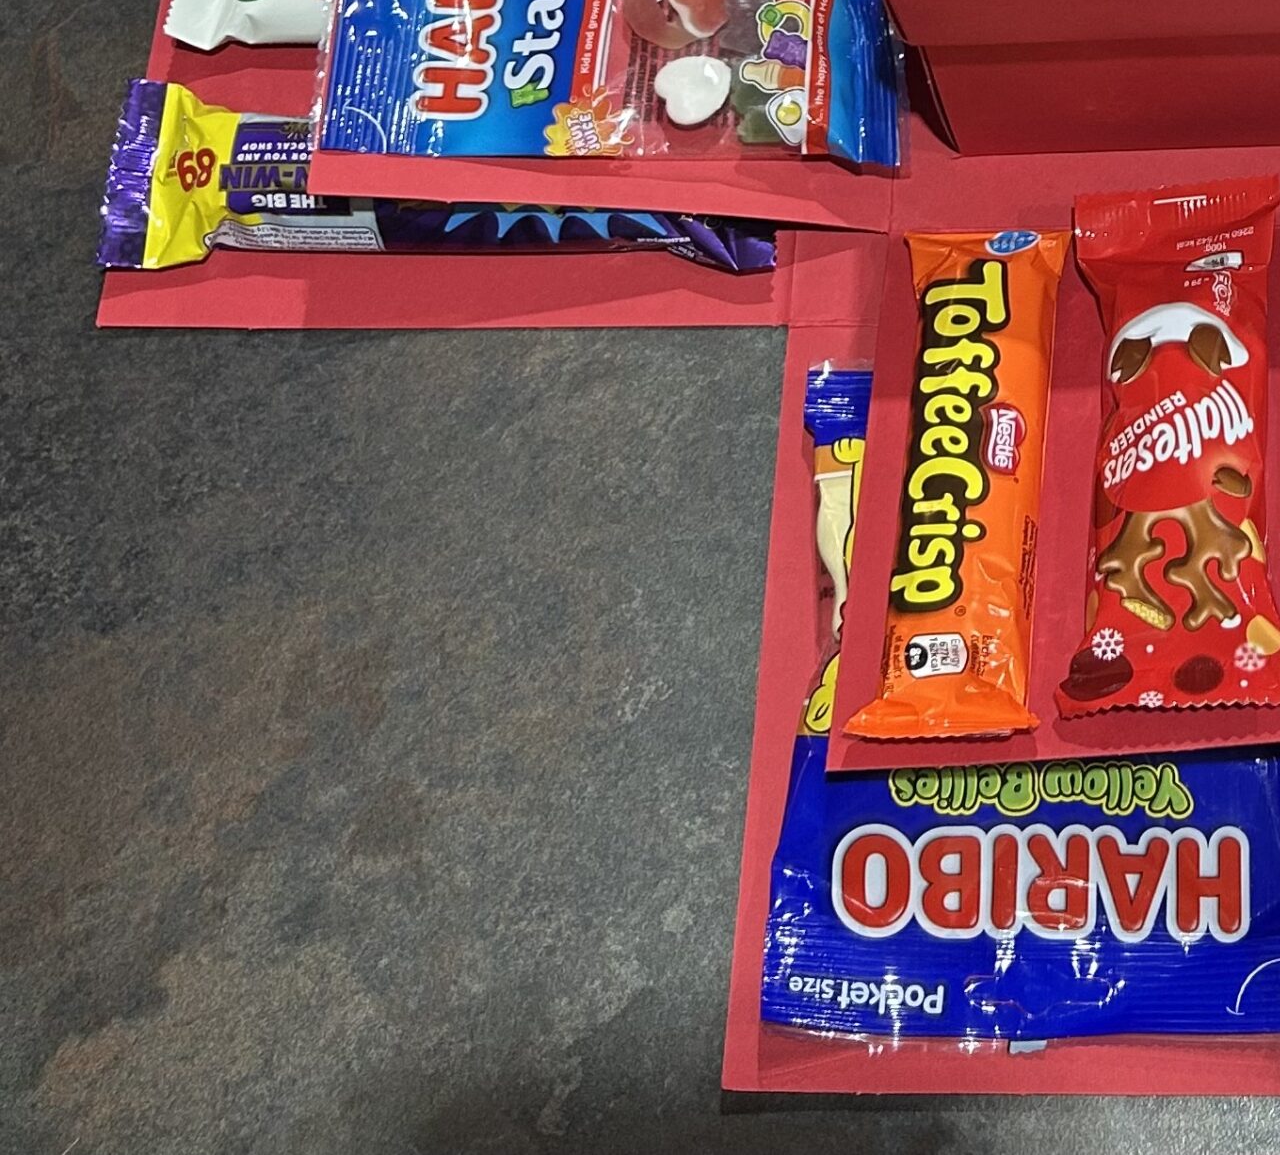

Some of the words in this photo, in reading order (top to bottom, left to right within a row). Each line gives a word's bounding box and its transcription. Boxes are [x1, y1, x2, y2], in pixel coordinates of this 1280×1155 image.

[583, 32, 594, 50] and
[580, 51, 592, 75] Kids
[816, 54, 827, 86] happy
[815, 88, 825, 106] the
[236, 152, 261, 162] AND
[263, 152, 288, 162] YOU
[242, 141, 273, 151] SHOP
[250, 193, 287, 209] BIG
[290, 193, 327, 209] THE
[1103, 379, 1255, 489] Maltesers
[1109, 390, 1187, 456] REINDEER
[890, 763, 1038, 814] Bellies
[1045, 763, 1192, 817] Yellow
[838, 830, 1244, 937] HARIBO
[840, 981, 945, 1015] Pocket
